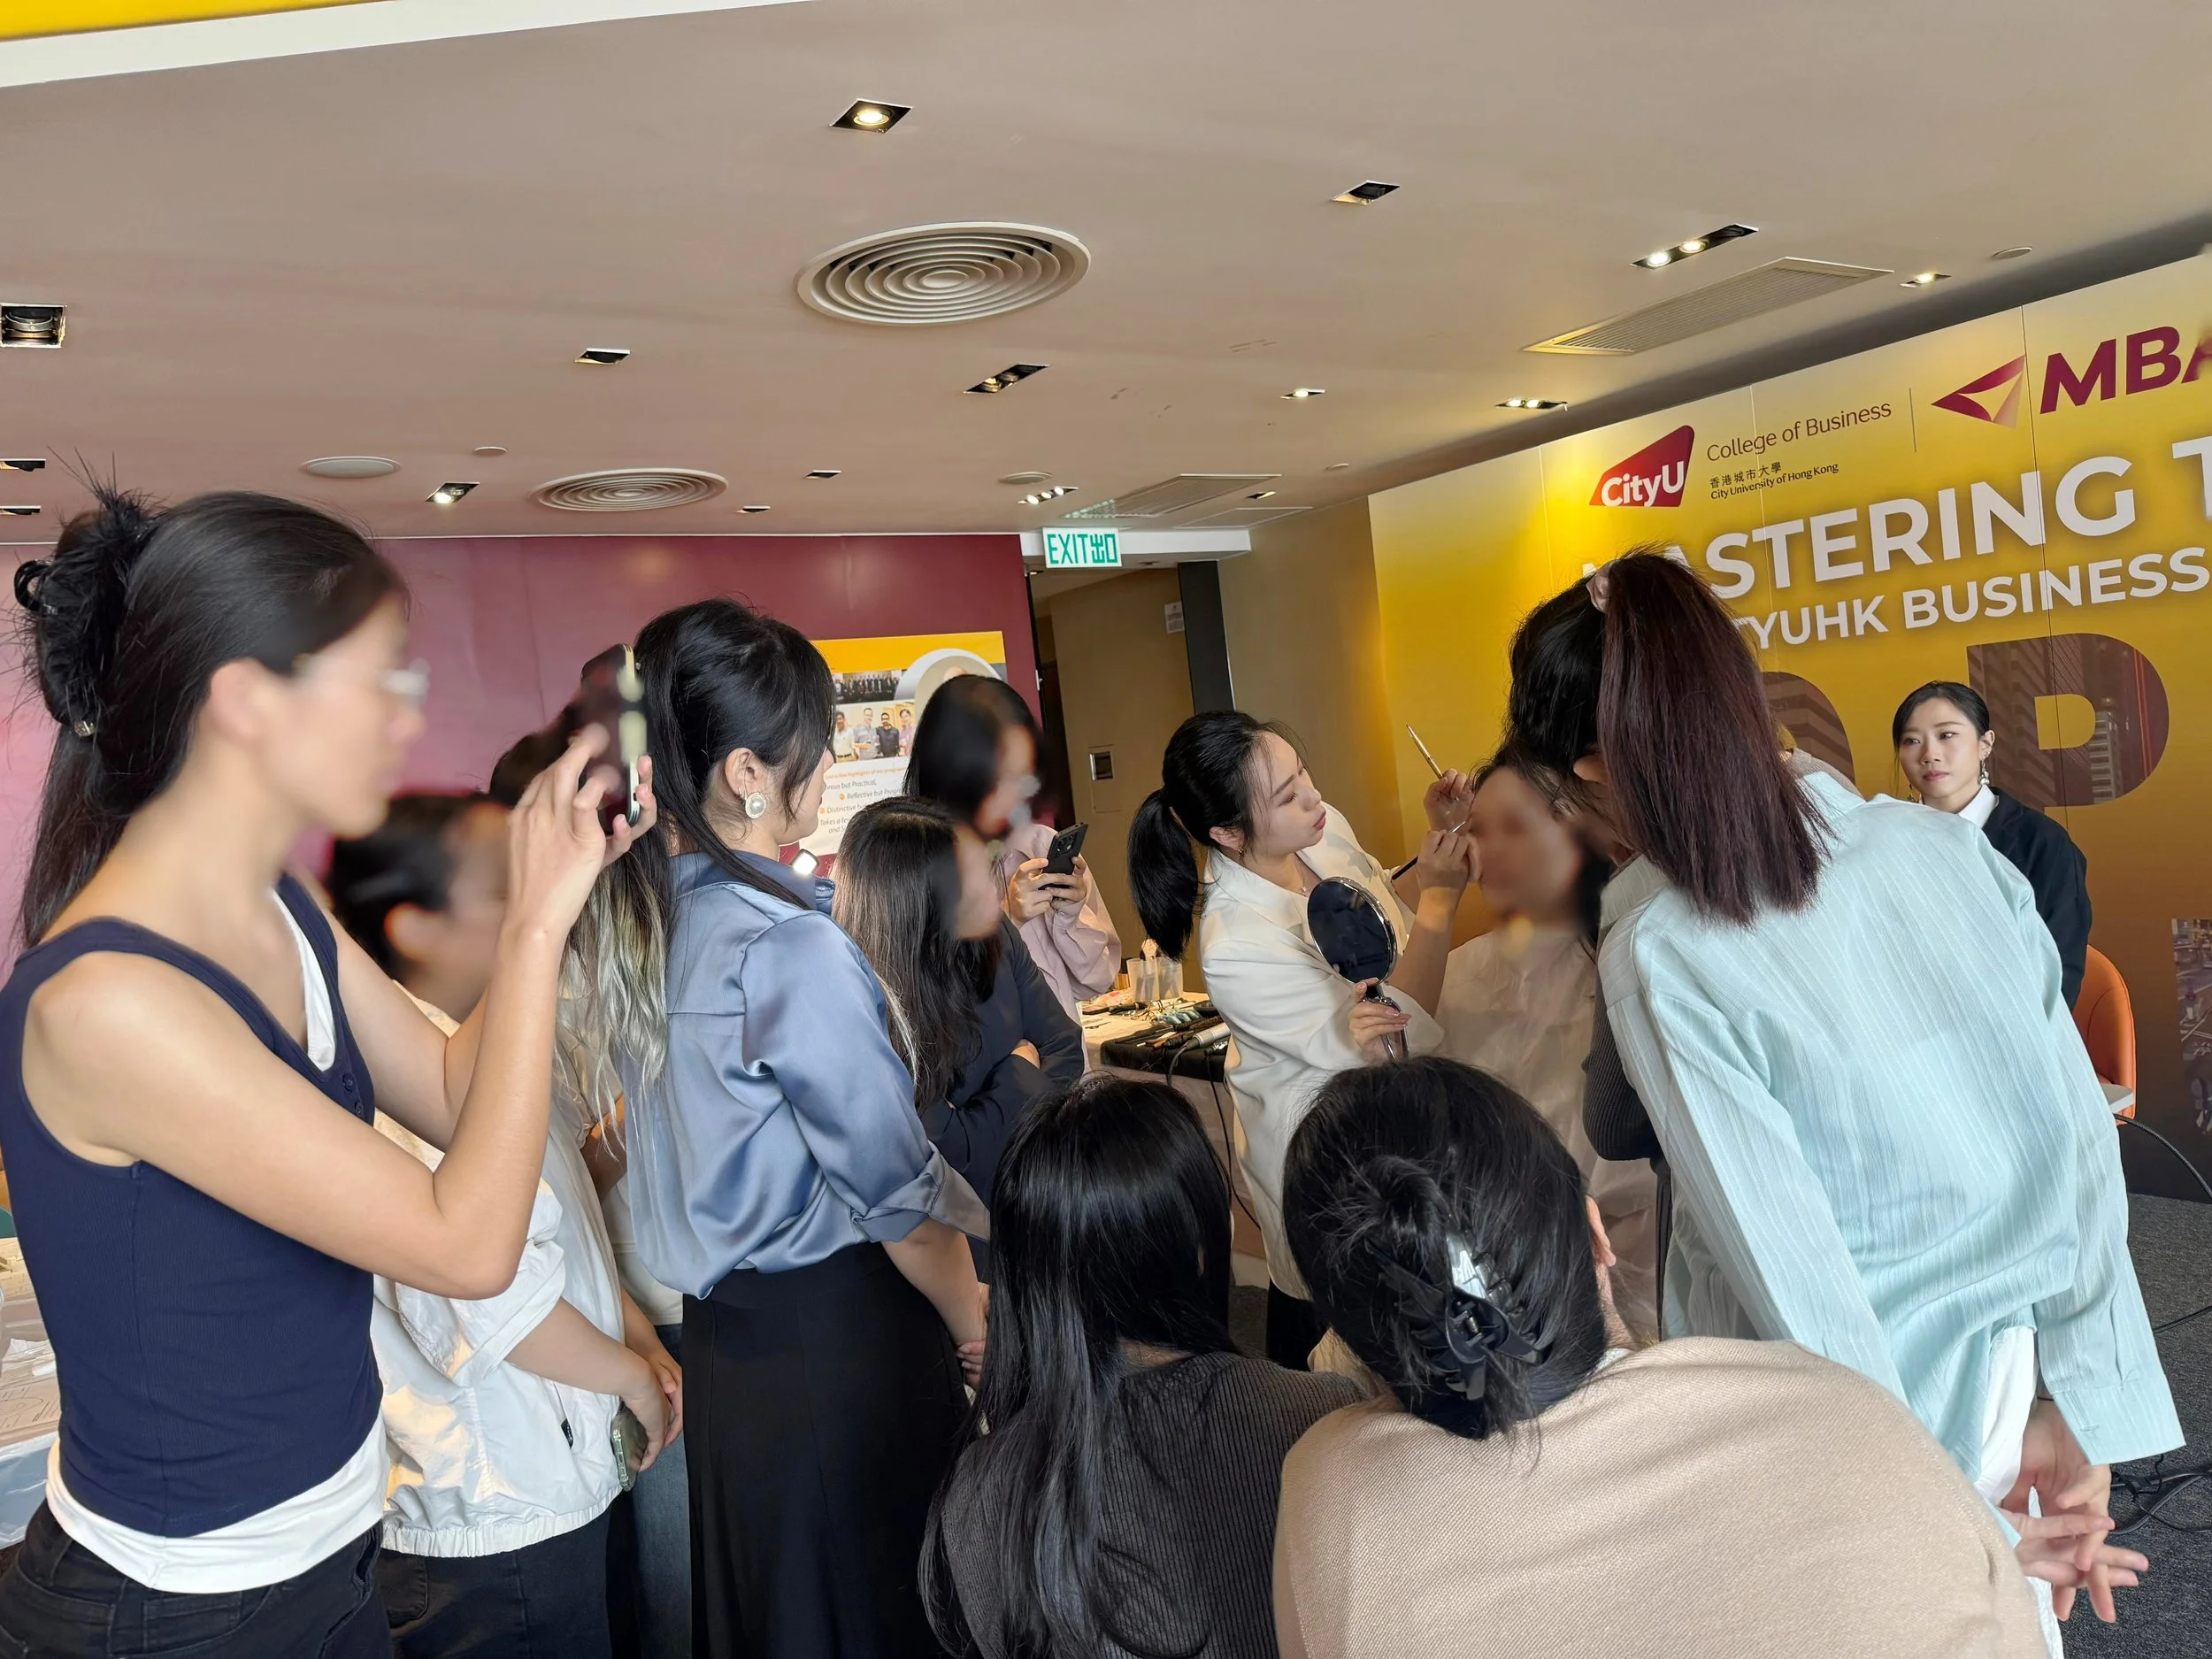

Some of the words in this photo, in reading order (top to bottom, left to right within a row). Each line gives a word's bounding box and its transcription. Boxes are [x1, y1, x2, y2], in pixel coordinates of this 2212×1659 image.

[1707, 431, 1777, 462] College
[1781, 420, 1802, 443] of
[1806, 403, 1893, 437] Business
[1601, 460, 1685, 508] CityU
[1709, 461, 1783, 488] 香港城市大學
[1710, 488, 1730, 500] City
[1730, 477, 1775, 495] University
[1777, 472, 1787, 485] of
[1788, 468, 1813, 482] Hong
[1813, 463, 1839, 475] Kong
[1047, 534, 1088, 565] EXIT
[1090, 534, 1118, 564] 出口
[1583, 456, 2137, 600] STERING
[1732, 595, 1890, 649] YUHK
[1902, 546, 2210, 629] BUSINESS
